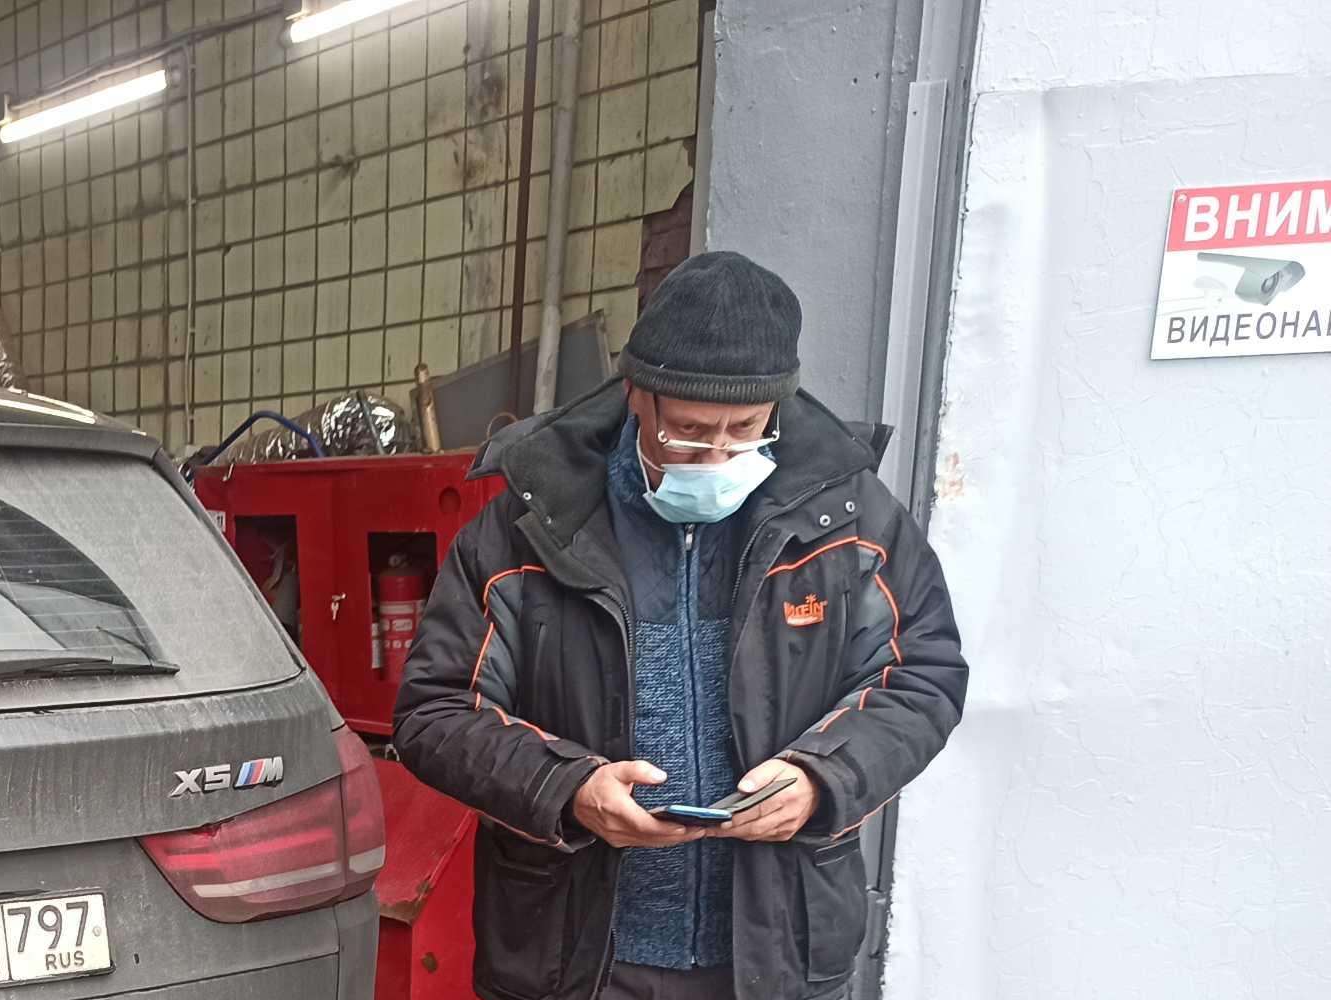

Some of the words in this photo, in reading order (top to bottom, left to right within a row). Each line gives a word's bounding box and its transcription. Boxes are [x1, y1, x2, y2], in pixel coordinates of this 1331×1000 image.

[1167, 310, 1331, 346] ВИДЕОНА
[170, 763, 231, 797] X5
[7, 902, 89, 953] 797
[45, 950, 85, 971] RUS
